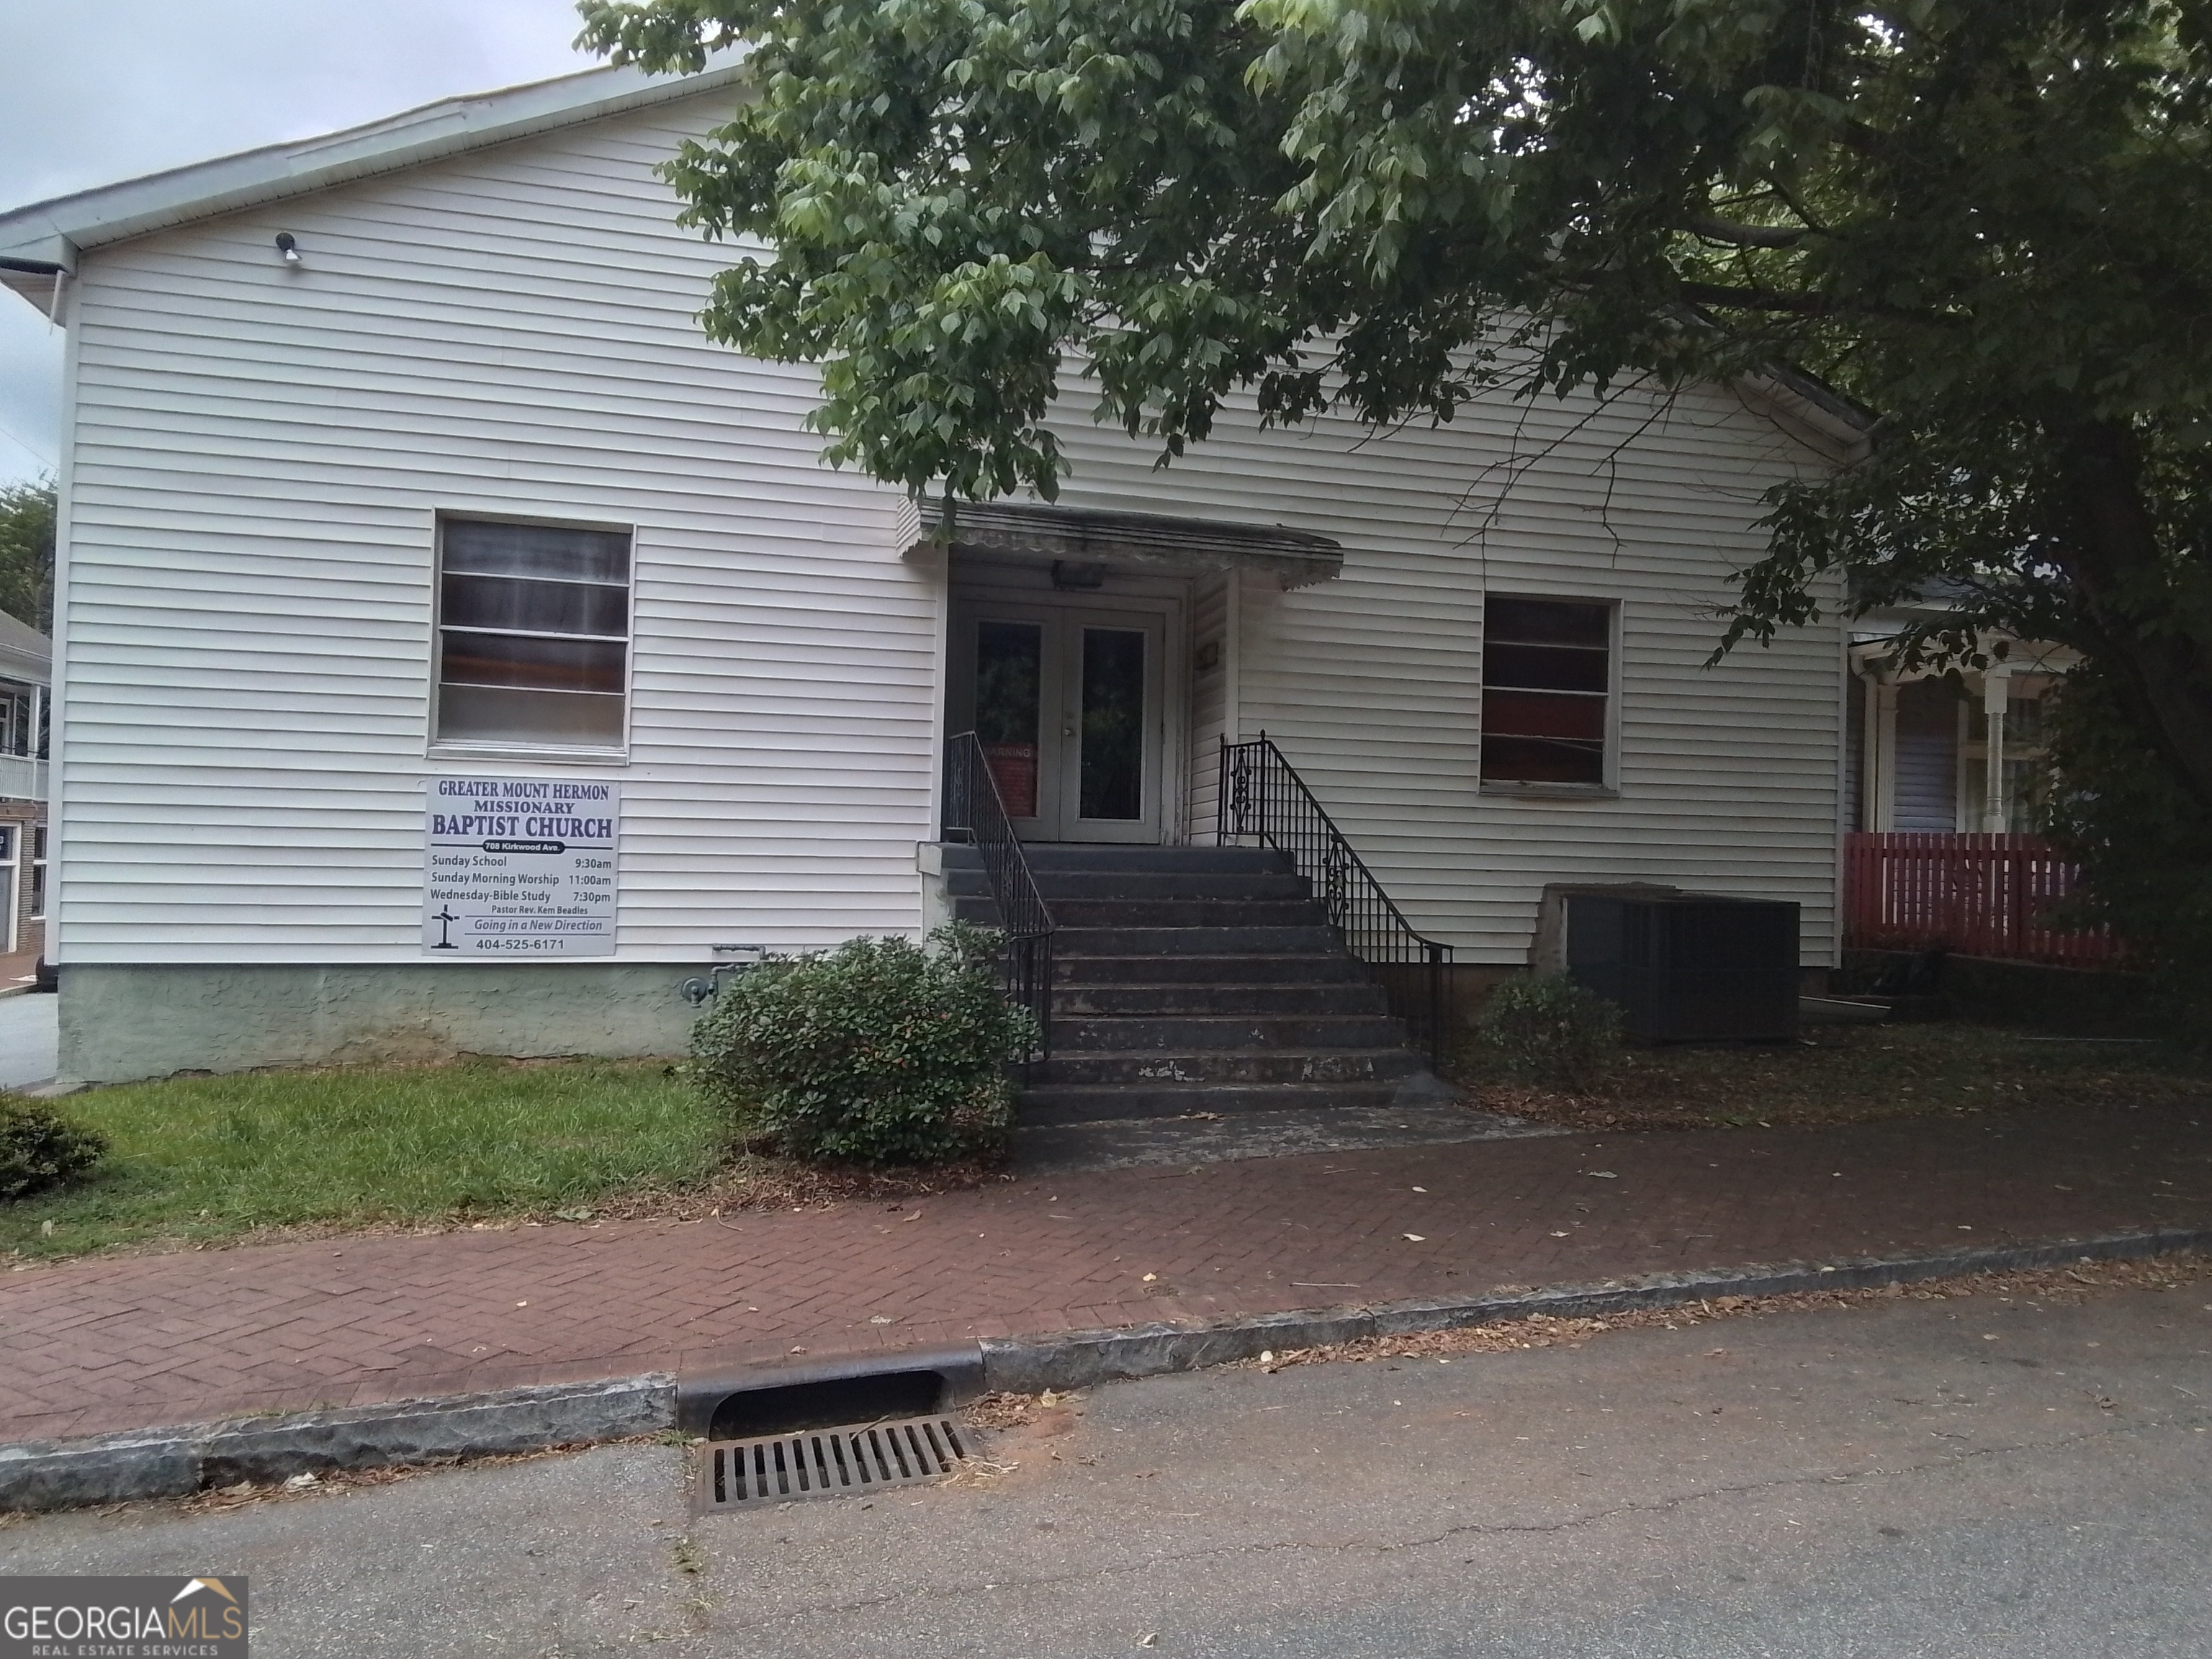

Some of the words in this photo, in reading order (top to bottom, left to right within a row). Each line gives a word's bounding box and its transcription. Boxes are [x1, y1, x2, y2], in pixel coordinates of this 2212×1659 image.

[439, 781, 498, 797] GREATER
[503, 783, 549, 798] MOUNT
[552, 784, 609, 800] HERMON
[474, 800, 575, 814] MISSIONARY
[432, 814, 519, 836] BAPTIST
[526, 817, 612, 837] CHURCH
[432, 855, 469, 868] Sunday
[472, 856, 507, 866] School
[575, 859, 611, 868] 9:30am
[432, 872, 469, 884] Sunday
[472, 873, 516, 886] Morning
[518, 874, 559, 886] Worship
[569, 876, 611, 885] 11:00am
[431, 889, 518, 902] Wednesday-Bible
[521, 891, 550, 903] Study
[573, 892, 611, 904] 7:30pm
[492, 905, 517, 914] Pastor
[475, 920, 506, 932] Going
[508, 920, 521, 930] in
[530, 920, 552, 930] New
[555, 920, 602, 930] Direction
[477, 939, 564, 949] 404-525-6171
